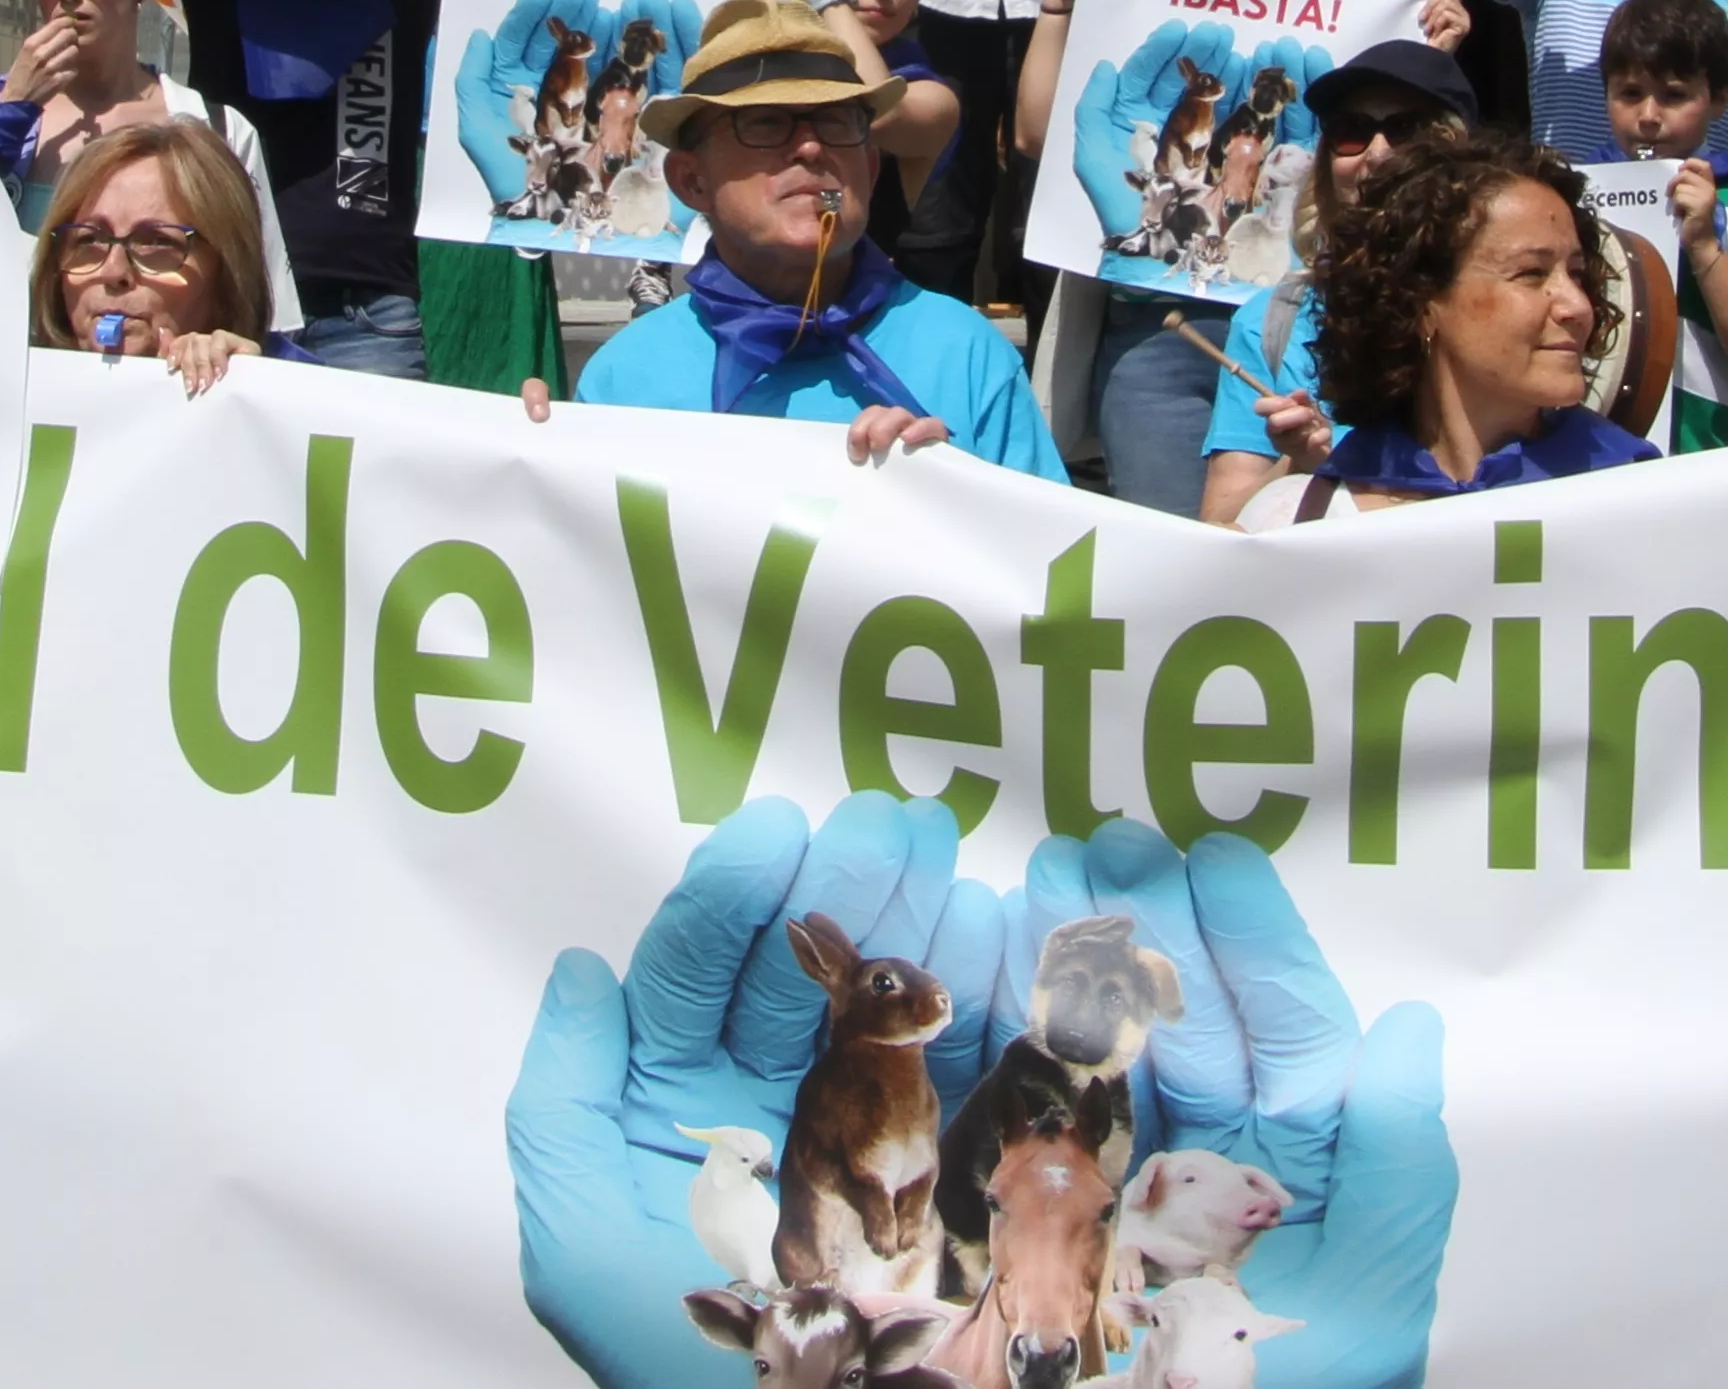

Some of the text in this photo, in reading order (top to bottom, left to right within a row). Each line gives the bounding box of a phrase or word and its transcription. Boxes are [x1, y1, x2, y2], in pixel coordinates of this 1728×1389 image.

[344, 44, 386, 152] EANS
[1583, 189, 1658, 208] ecemos
[169, 433, 535, 814] de
